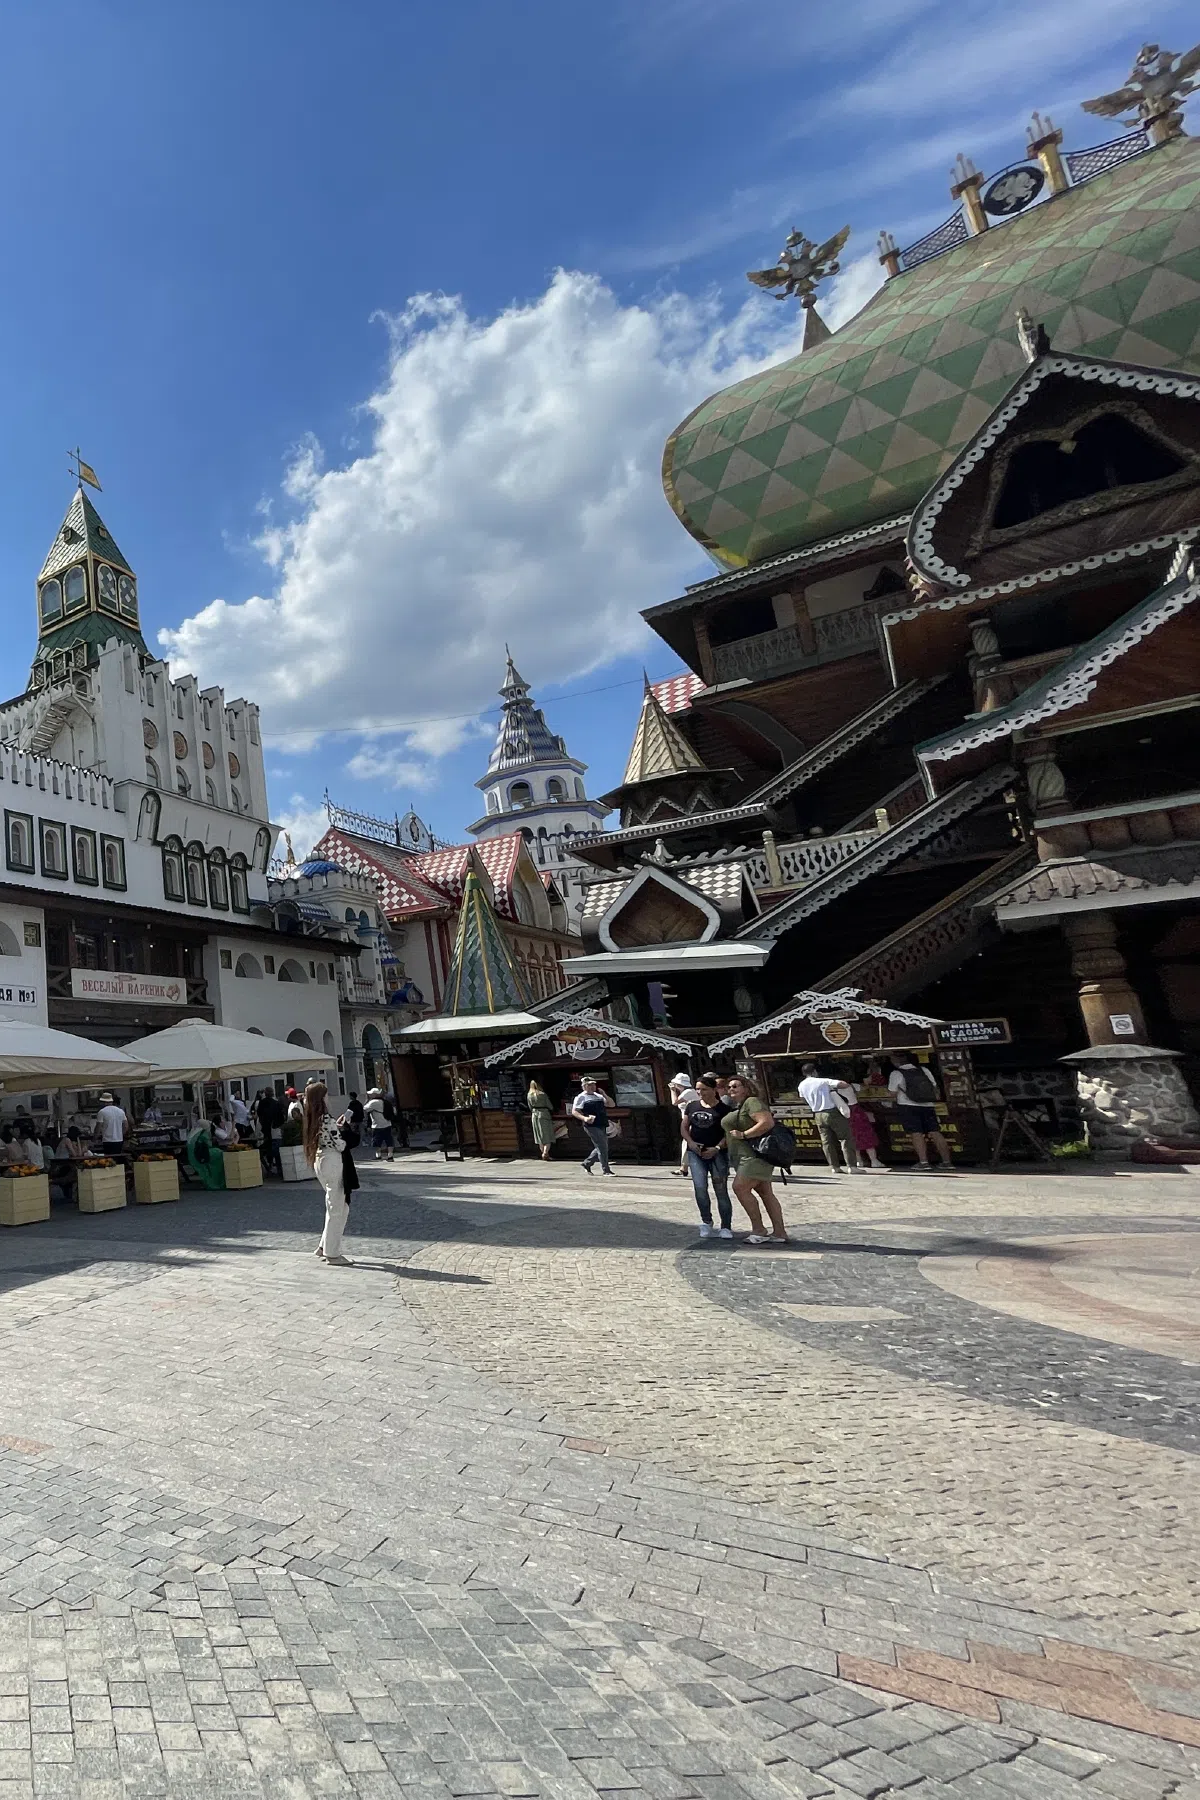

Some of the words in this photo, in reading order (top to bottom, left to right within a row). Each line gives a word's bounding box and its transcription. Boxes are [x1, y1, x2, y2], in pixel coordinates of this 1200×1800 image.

[82, 979, 124, 994] ВЕСЕЛЫЙ
[128, 983, 166, 997] ВАРЕНИК
[941, 1027, 1000, 1038] МЕДОВУХА
[553, 1038, 585, 1057] Hot
[586, 1036, 621, 1053] Dog
